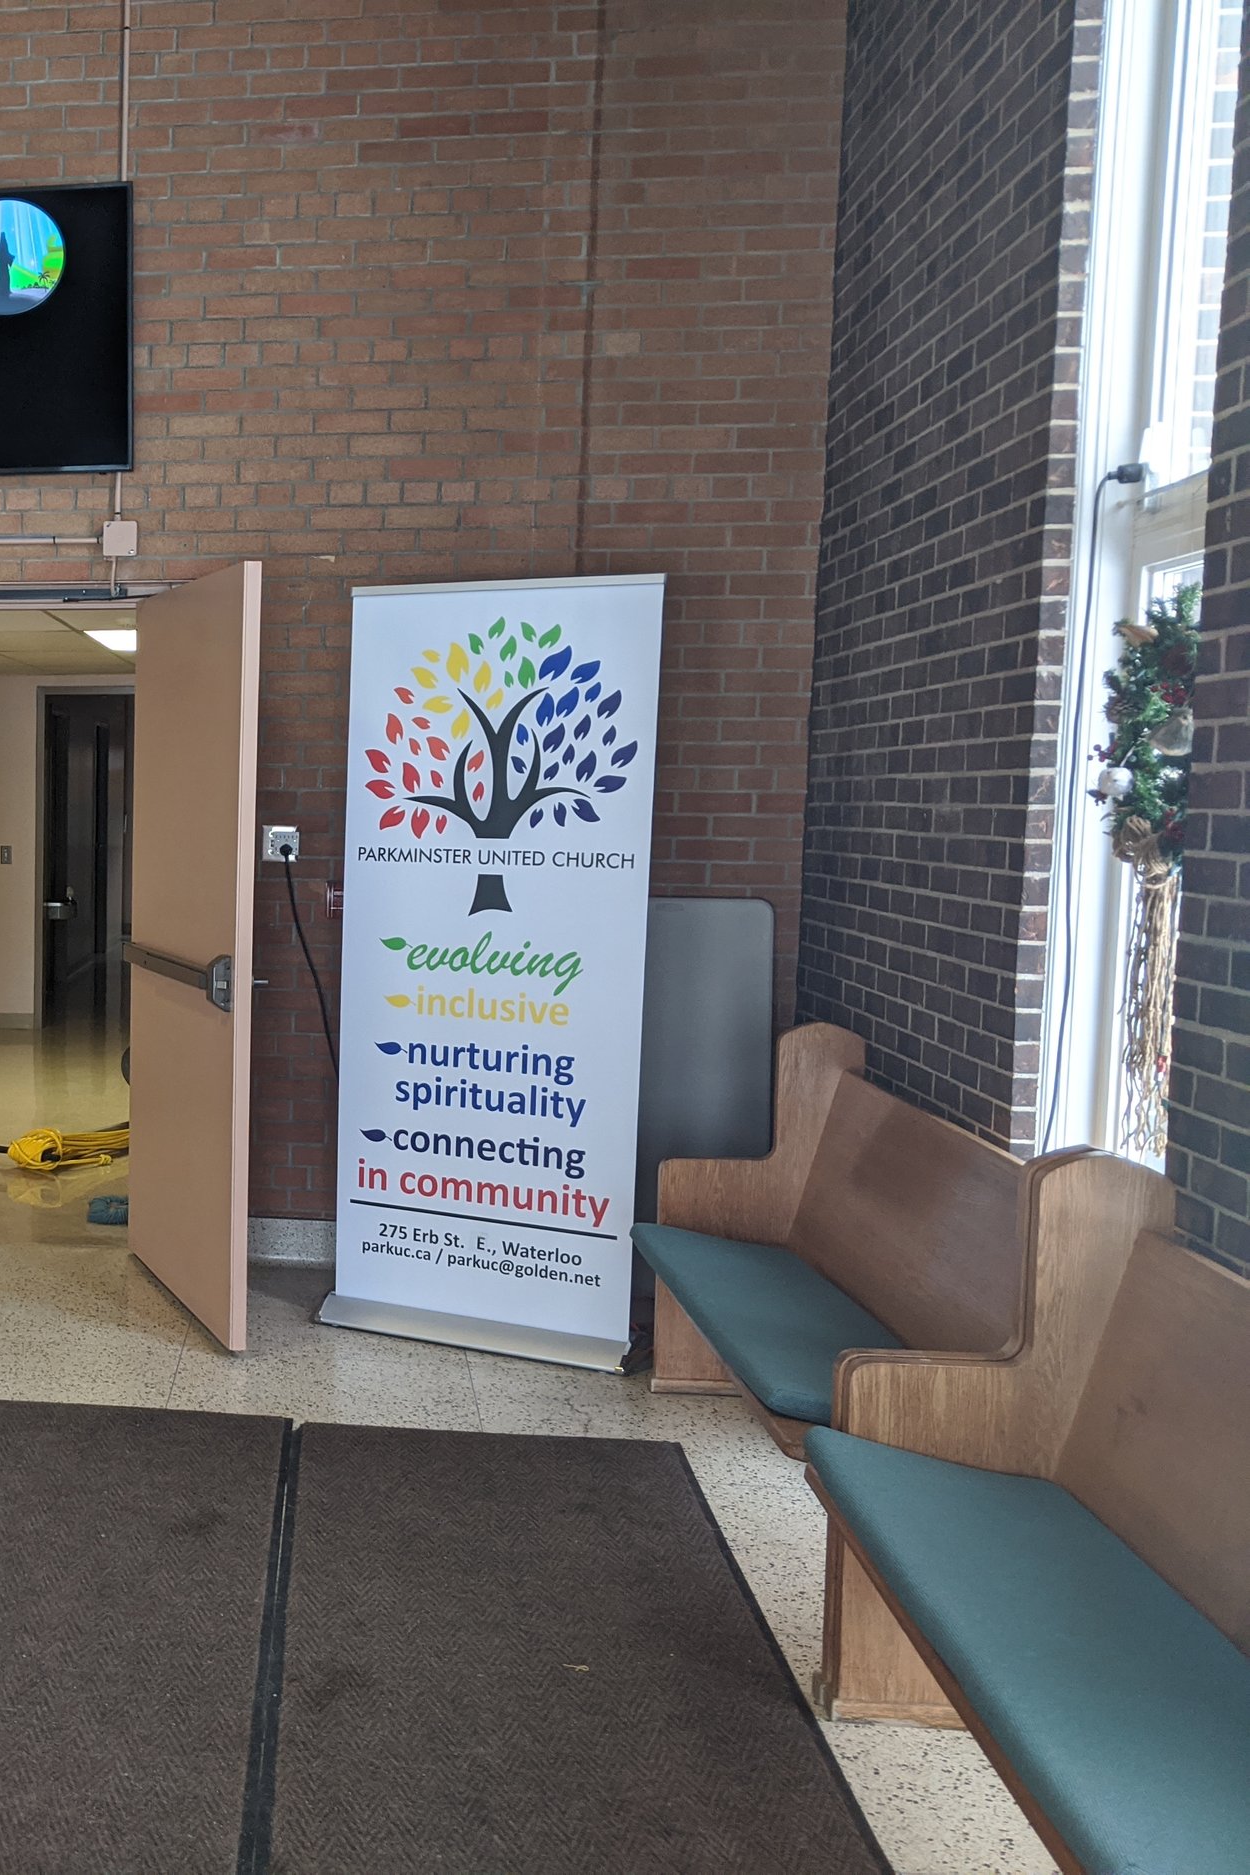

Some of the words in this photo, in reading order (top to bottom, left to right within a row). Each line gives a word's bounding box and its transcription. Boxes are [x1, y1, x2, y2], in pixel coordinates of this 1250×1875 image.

[358, 847, 472, 865] PARKMINSTER
[478, 850, 545, 866] UNITED
[553, 851, 634, 869] CHURCH
[406, 931, 584, 996] evolving
[417, 986, 569, 1026] inclusive
[408, 1041, 575, 1085] nurturing
[395, 1077, 586, 1127] spirituality
[393, 1128, 586, 1179] connecting
[358, 1159, 387, 1190] in
[400, 1172, 609, 1228] community
[362, 1240, 430, 1261] parkuc.ca
[436, 1249, 443, 1264] /
[447, 1252, 601, 1287] parkuc@golden.net
[379, 1223, 407, 1239] 275
[413, 1228, 439, 1244] Erb
[444, 1233, 464, 1248] St.
[477, 1237, 496, 1255] E.,
[502, 1241, 581, 1266] Waterloo
